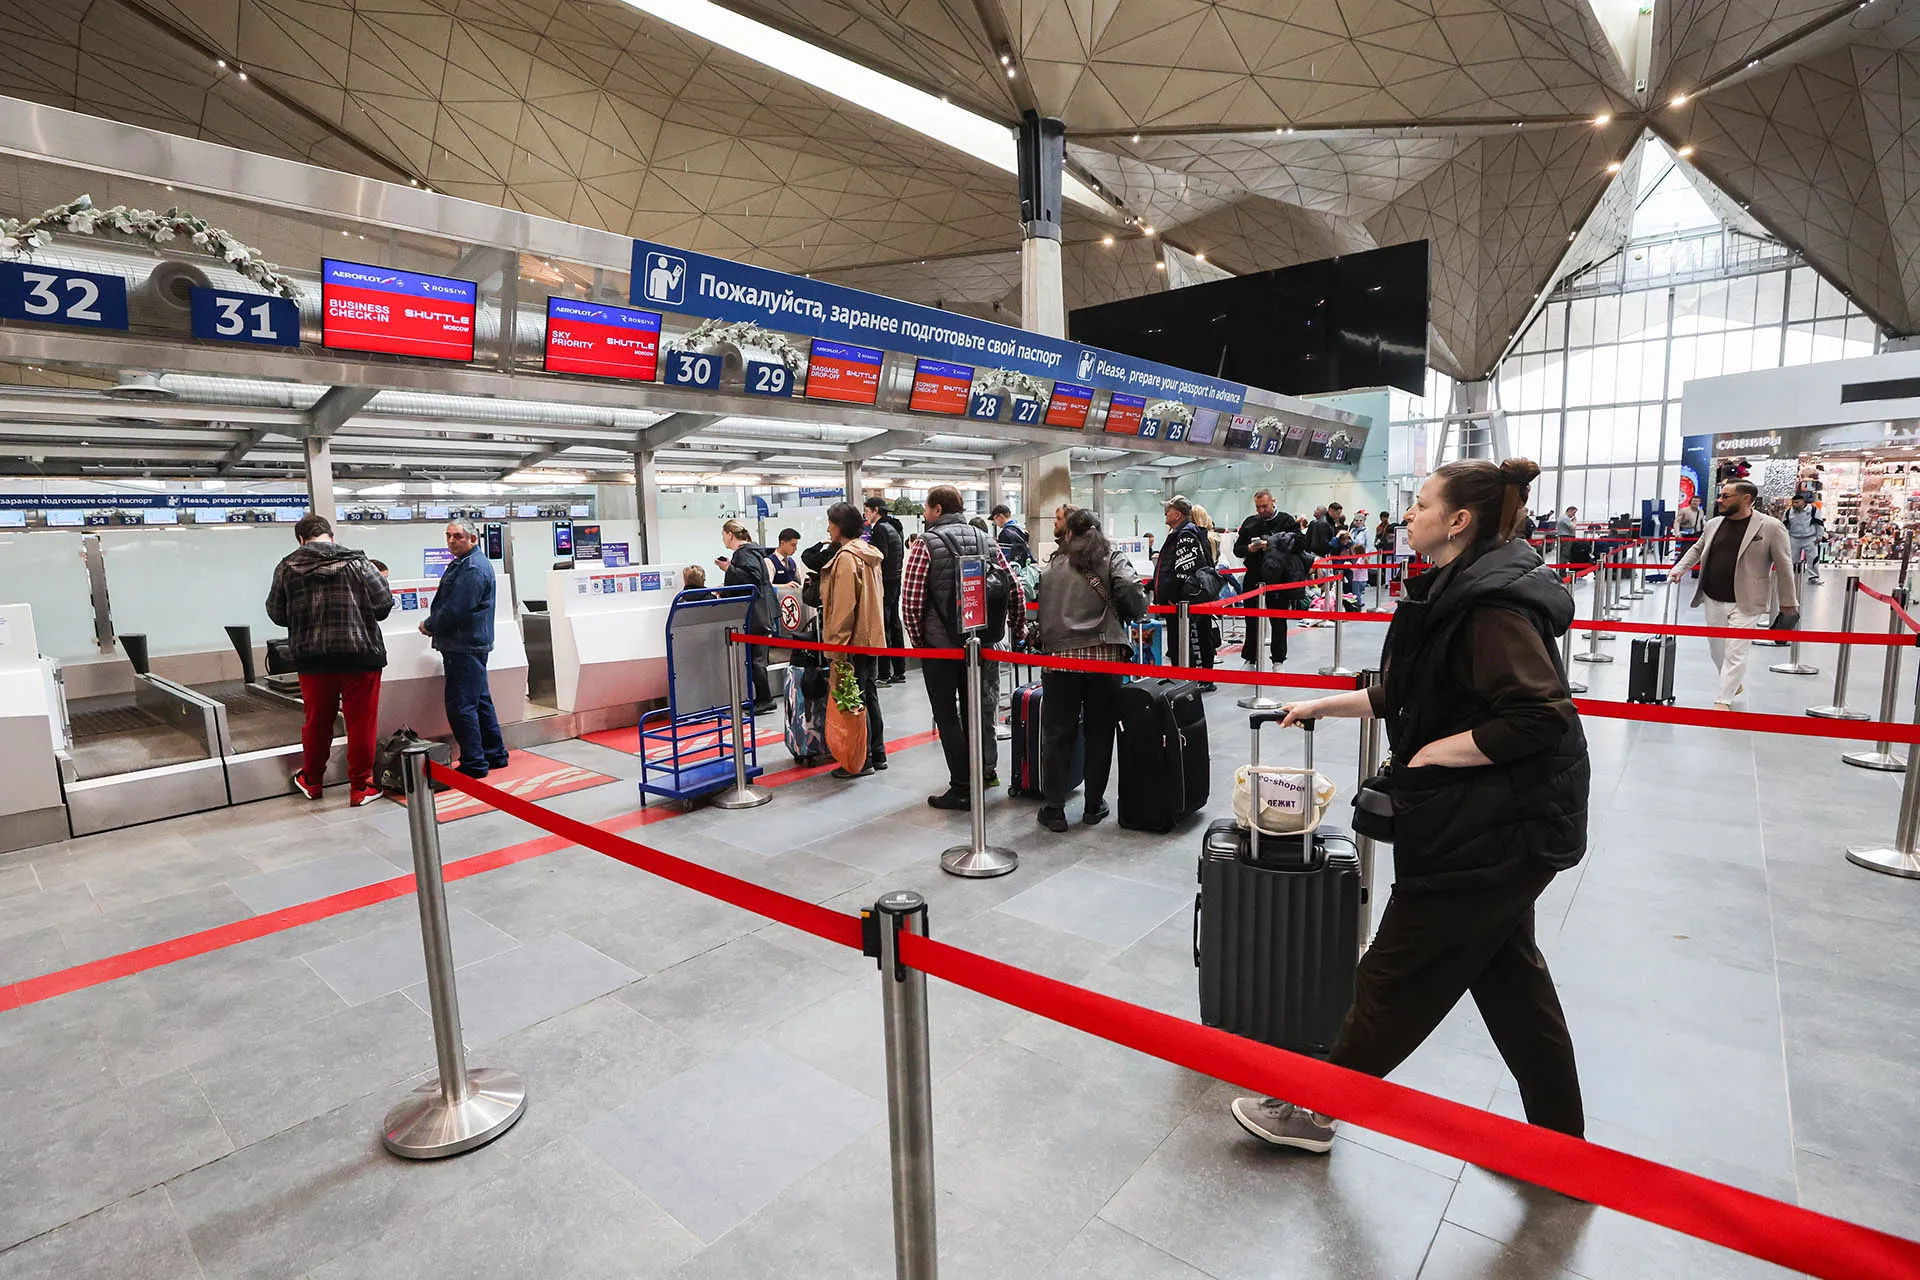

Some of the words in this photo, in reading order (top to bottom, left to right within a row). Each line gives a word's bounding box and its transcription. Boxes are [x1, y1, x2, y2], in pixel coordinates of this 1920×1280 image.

[332, 270, 382, 283] AEROFLOT
[22, 271, 102, 322] 32
[432, 286, 467, 296] ROSSIYA
[329, 298, 390, 314] BUSINESS
[555, 306, 591, 317] AEROFLOT
[215, 297, 278, 340] 31
[329, 307, 390, 323] CHECK-IN
[404, 308, 470, 325] SHUTTLE
[628, 317, 654, 326] ROSSIYA
[699, 272, 827, 323] Пожалуйста,
[829, 304, 899, 333] заранее
[901, 320, 985, 350] подготовьте
[987, 338, 1015, 357] свой
[1017, 345, 1062, 368] паспорт
[442, 324, 470, 333] MOSCOW
[551, 330, 571, 339] SKY
[551, 337, 594, 349] PRIORITY
[606, 337, 655, 350] SHUTTLE
[677, 355, 712, 385] 30
[810, 370, 841, 380] DROP-OFF
[811, 365, 840, 374] BAGGAGE
[846, 369, 878, 380] SHUTTLE
[755, 366, 785, 393] 29
[1096, 359, 1127, 382] Please,
[1129, 370, 1161, 387] prepare
[1160, 376, 1179, 391] your
[1178, 379, 1210, 398] passport
[1208, 386, 1216, 399] in
[1215, 388, 1241, 404] advance
[976, 396, 997, 417] 28
[1018, 402, 1038, 421] 27
[1143, 420, 1157, 437] 26
[1169, 425, 1183, 440] 25
[1250, 436, 1260, 449] 24
[1267, 439, 1278, 453] 23
[1323, 447, 1332, 459] 22
[1335, 449, 1344, 460] 21
[41, 497, 96, 505] подготовьте
[97, 496, 118, 504] свой
[119, 497, 153, 505] паспорт
[261, 497, 293, 505] passport
[91, 517, 105, 525] 54
